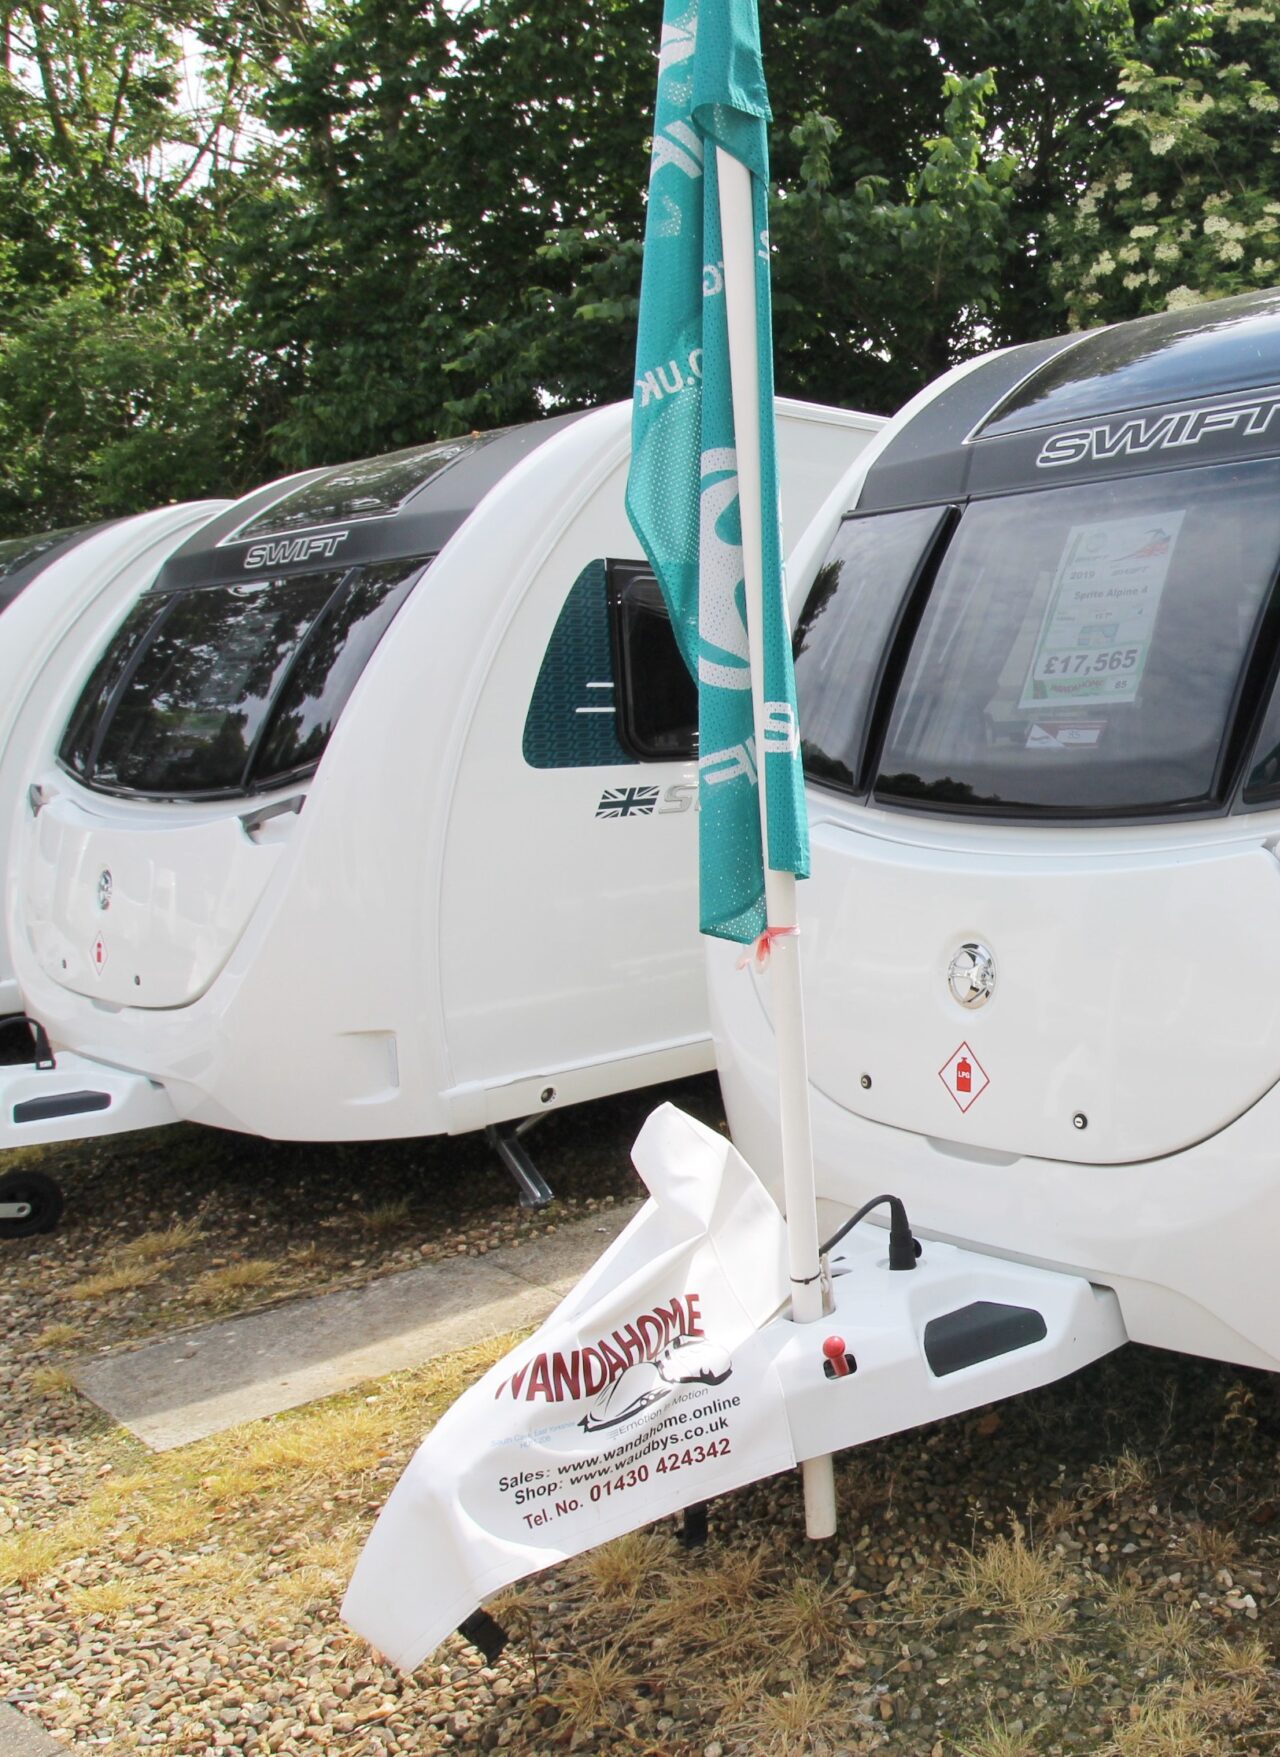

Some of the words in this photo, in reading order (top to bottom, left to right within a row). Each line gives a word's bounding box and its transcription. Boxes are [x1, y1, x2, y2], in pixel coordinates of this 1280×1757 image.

[244, 530, 350, 569] SWIFT
[1106, 587, 1138, 599] Alpine
[1043, 649, 1138, 676] £17,565
[618, 1408, 662, 1434] Emotion
[671, 1387, 709, 1406] Motion
[499, 1469, 550, 1492] Sales:
[558, 1395, 741, 1475] www.wandahome.online
[514, 1480, 563, 1505] Shop:
[570, 1416, 729, 1485] www.waudbys.co.uk
[523, 1508, 553, 1529] Tel.
[555, 1498, 584, 1517] No.
[590, 1464, 649, 1501] 01430
[656, 1438, 732, 1474] 424342
